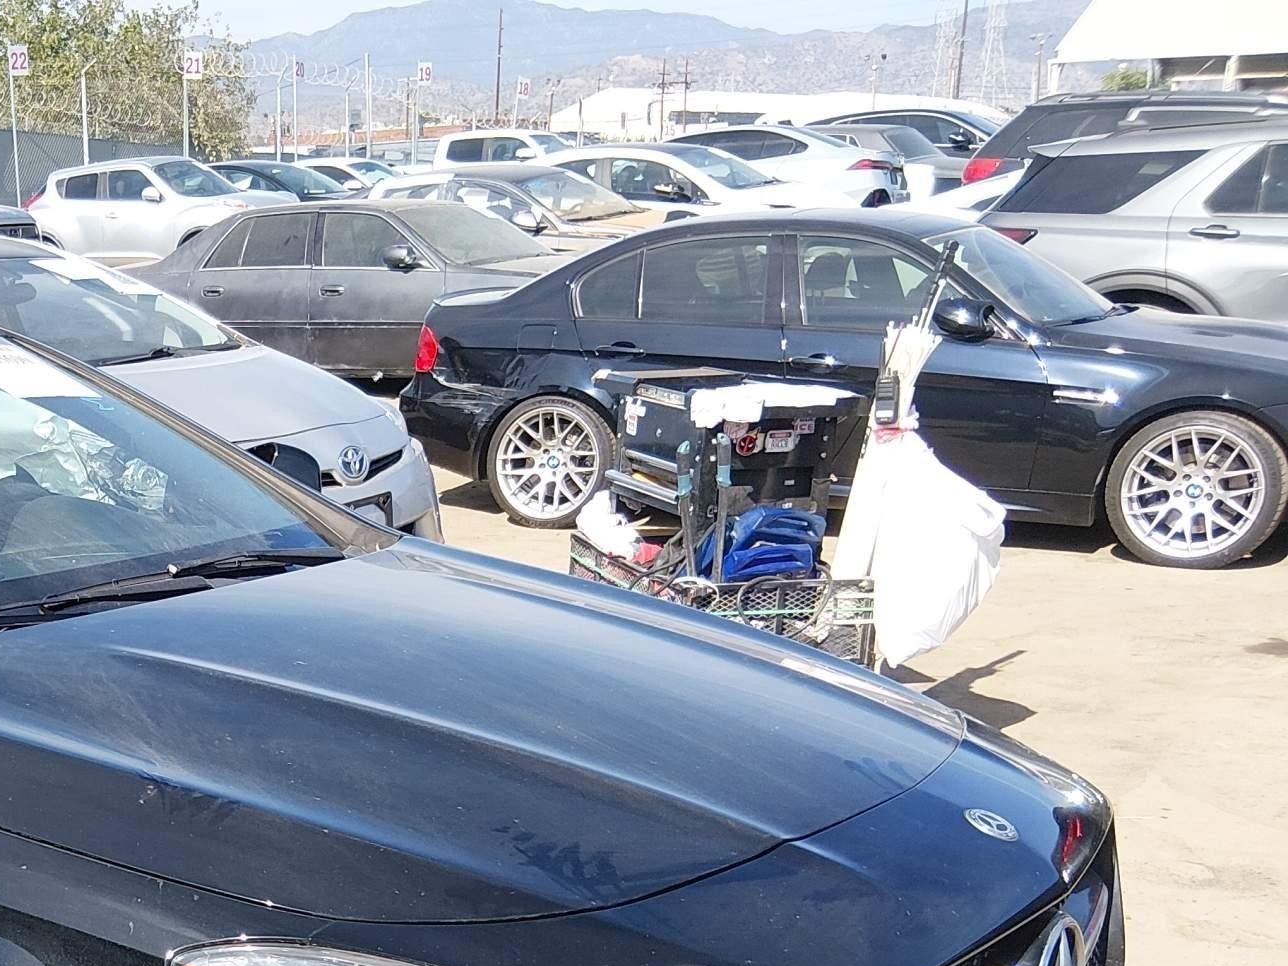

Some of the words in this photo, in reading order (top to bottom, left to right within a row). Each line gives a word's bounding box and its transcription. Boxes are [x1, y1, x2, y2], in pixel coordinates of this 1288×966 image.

[11, 51, 28, 70] 22
[185, 56, 201, 74] 21
[418, 66, 431, 81] 19
[518, 81, 529, 96] 18
